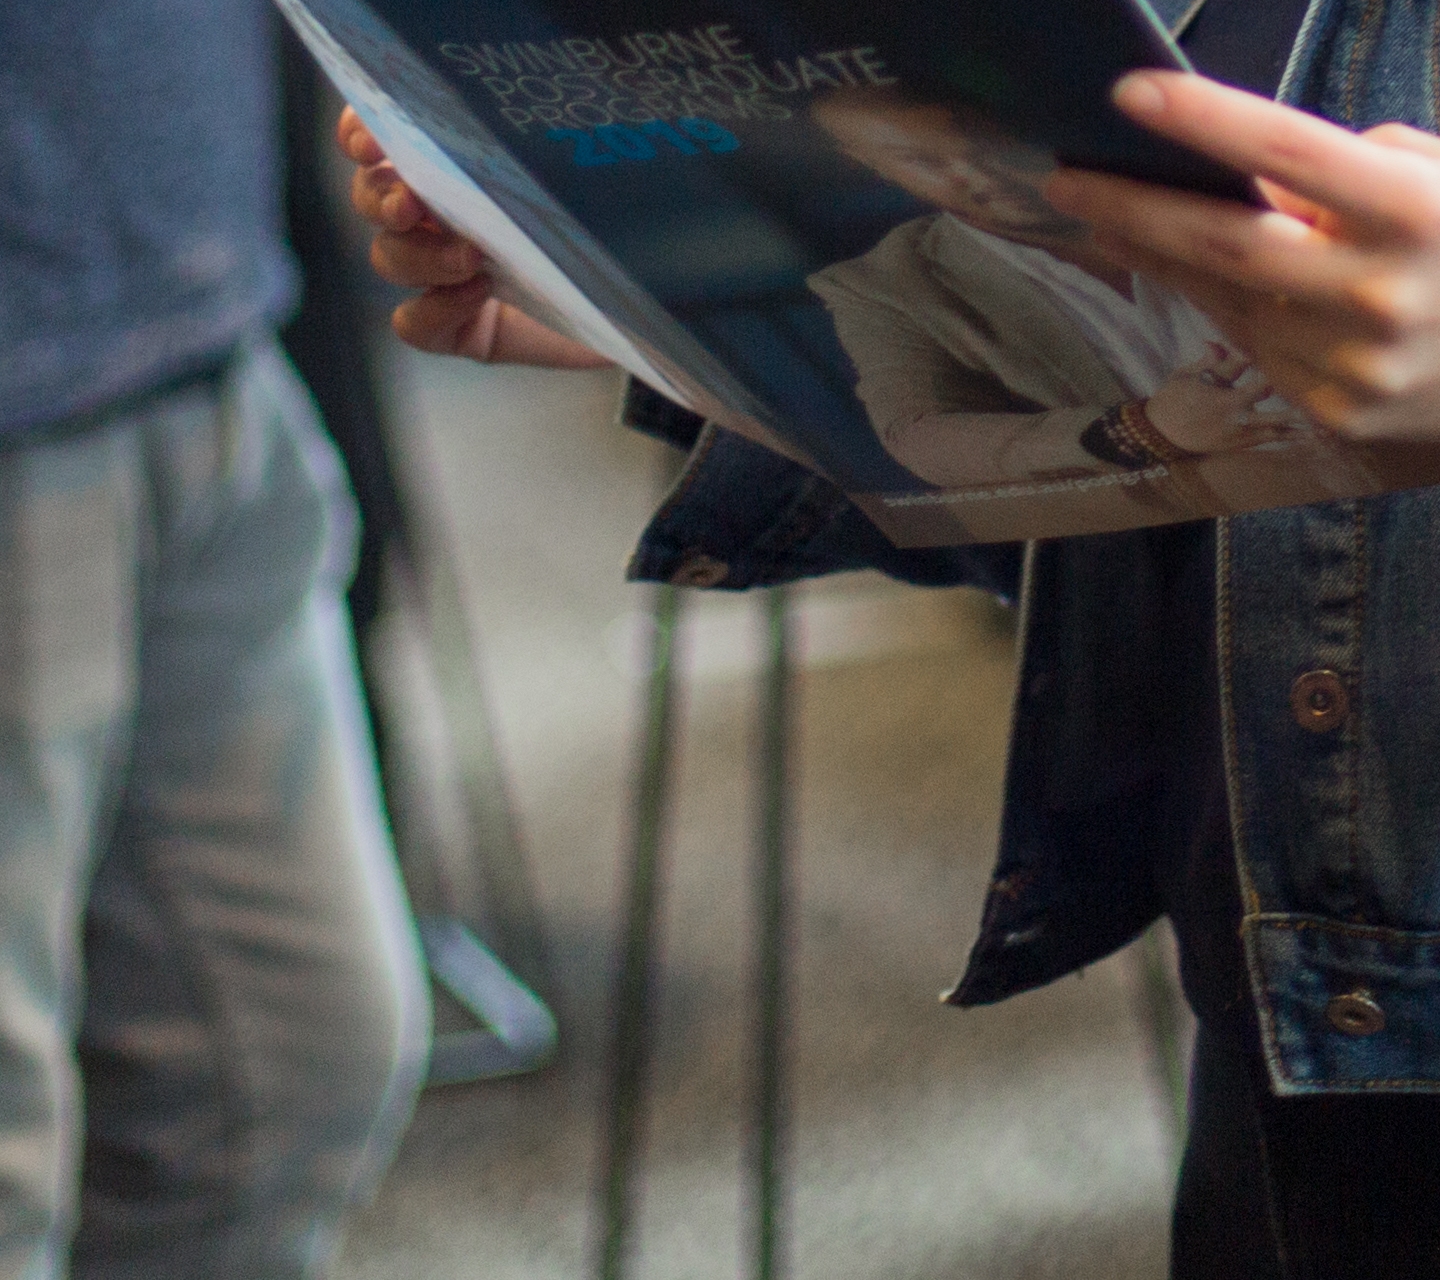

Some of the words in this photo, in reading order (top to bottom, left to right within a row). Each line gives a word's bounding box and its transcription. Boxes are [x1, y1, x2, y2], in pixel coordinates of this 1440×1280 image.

[439, 24, 753, 75] SWINBURNE
[482, 47, 899, 103] POSTGRADUATE
[500, 92, 792, 134] PROGRAMS
[545, 116, 740, 167] 2019
